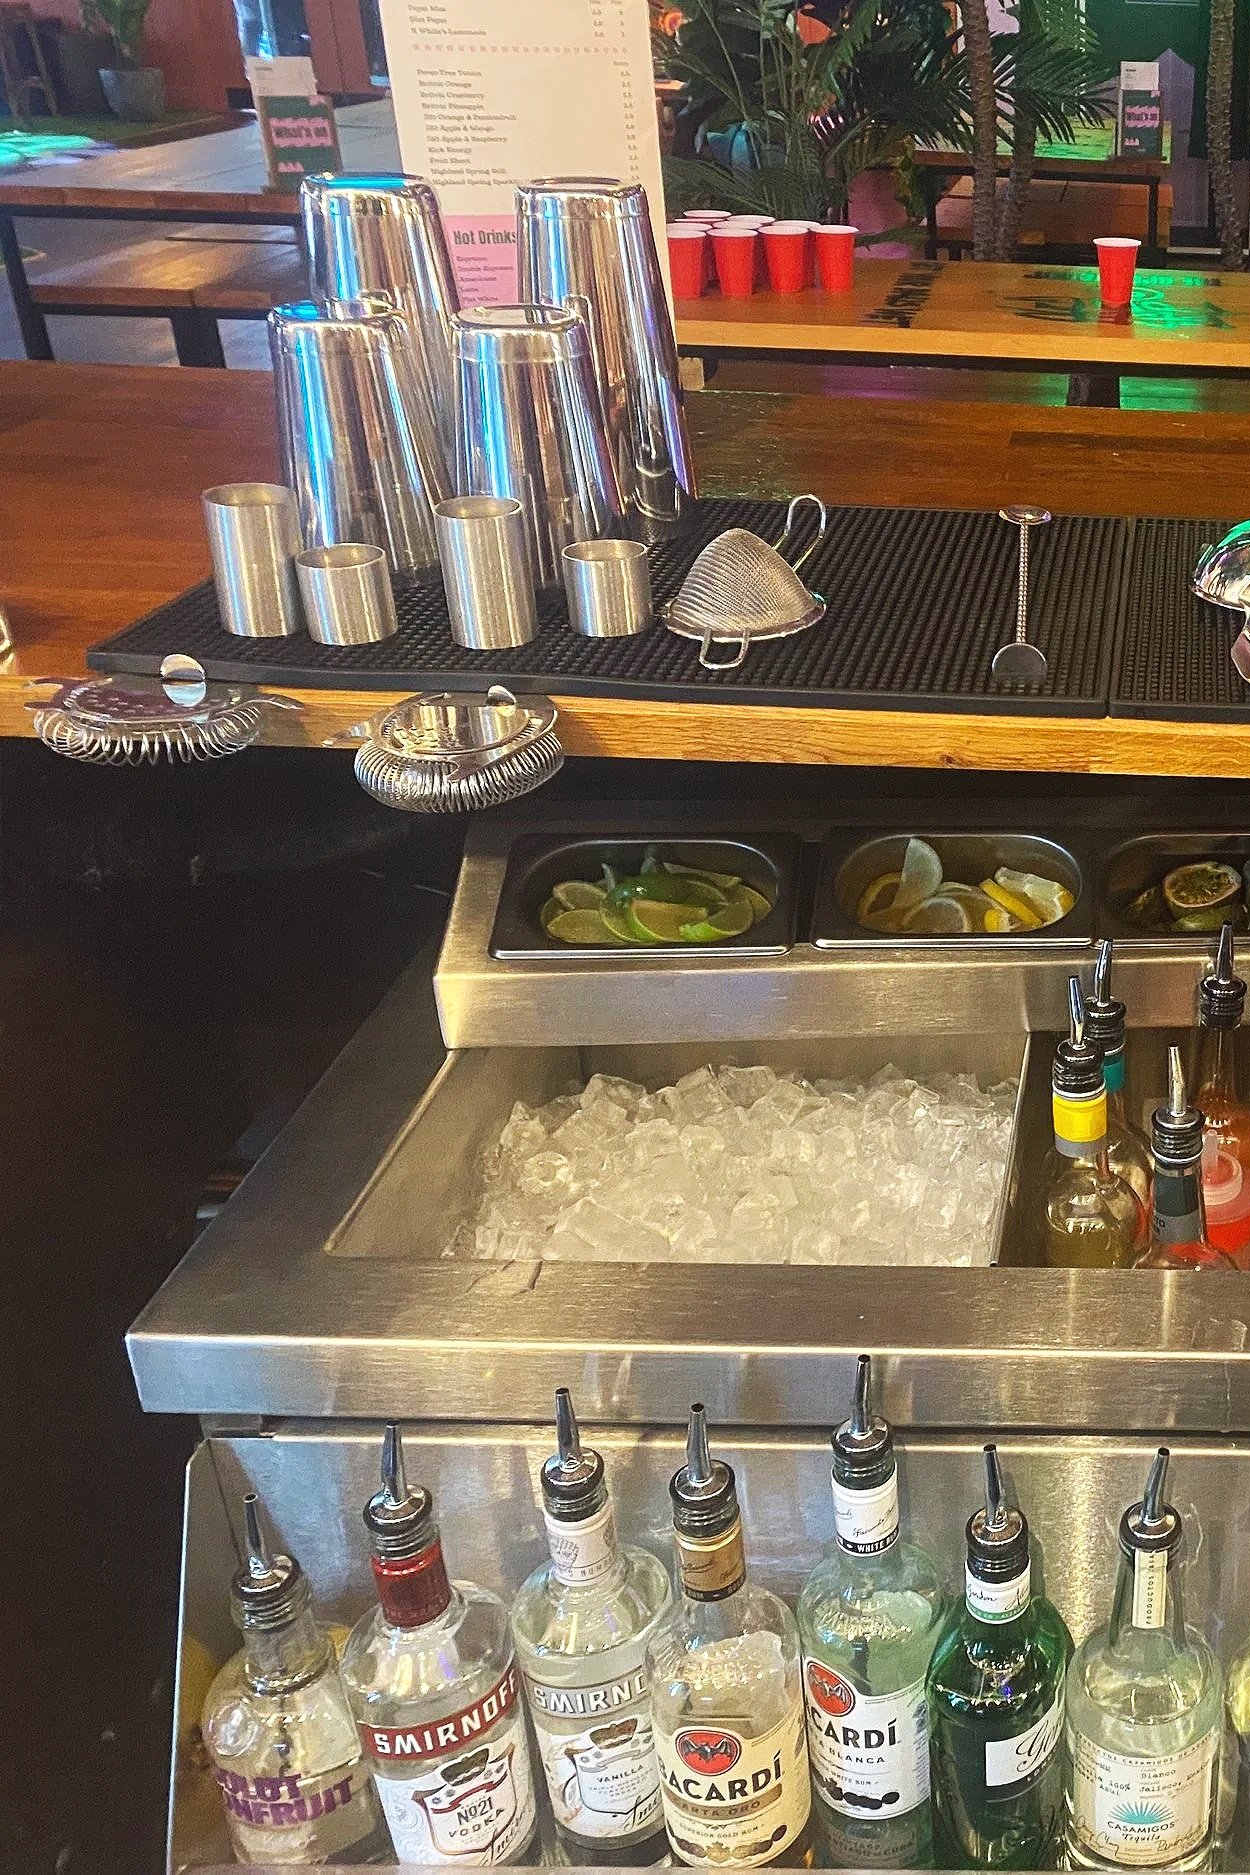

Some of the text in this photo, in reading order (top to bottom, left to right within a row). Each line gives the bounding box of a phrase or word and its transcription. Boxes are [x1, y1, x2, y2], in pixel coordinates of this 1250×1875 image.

[453, 229, 516, 245] Hot Drinks
[857, 1539, 884, 1554] WHITE
[373, 1668, 517, 1755] SMIRNOFF
[828, 1747, 886, 1764] BLANCA
[597, 1763, 645, 1784] VANILLA
[1141, 1769, 1176, 1780] Blanco
[1109, 1779, 1131, 1792] 100%
[728, 1800, 761, 1816] ORO
[448, 1807, 506, 1839] VODKA
[1107, 1819, 1176, 1834] CASAMIGOS
[1122, 1832, 1161, 1844] Tequila
